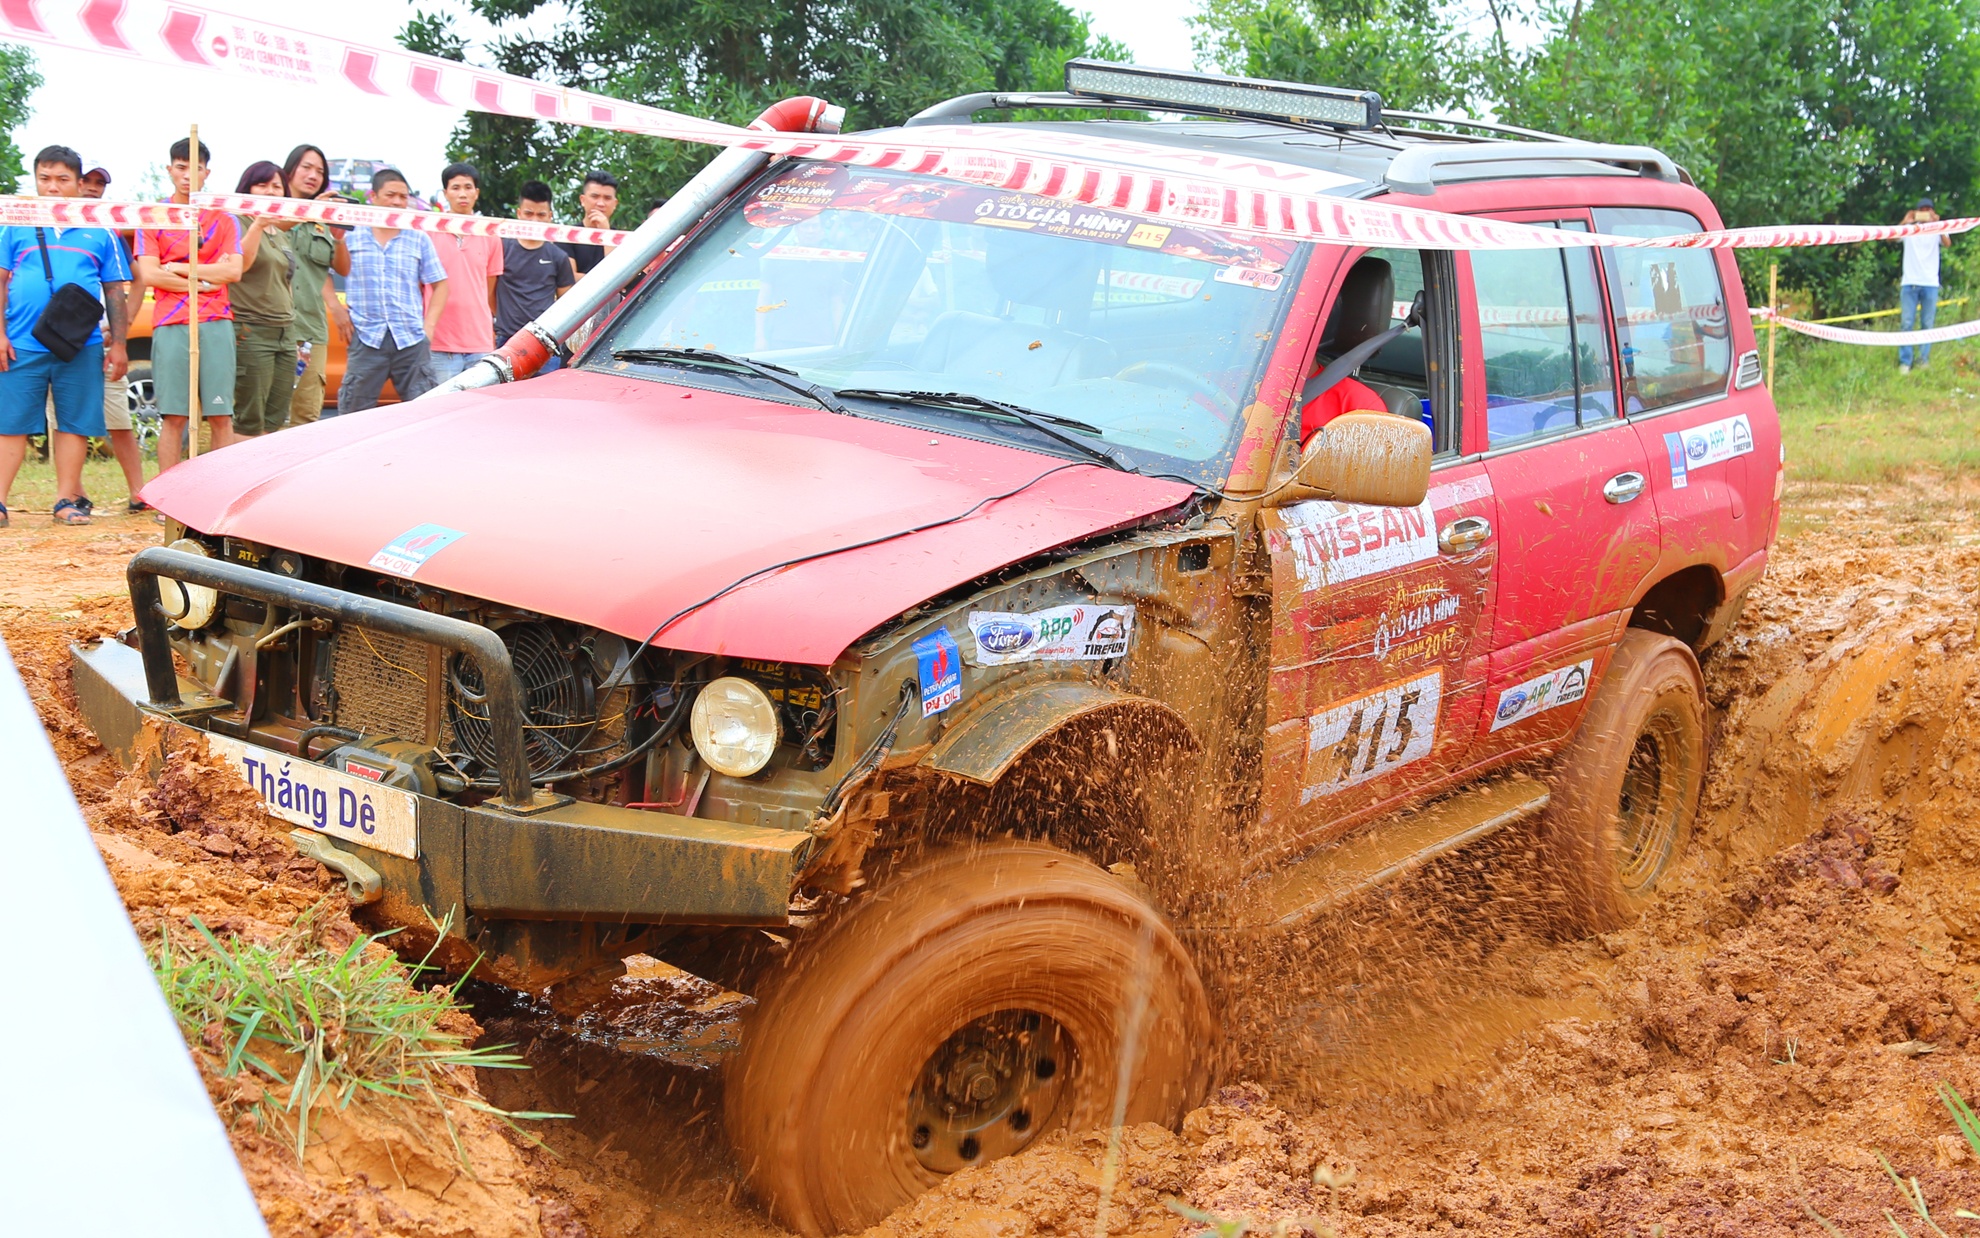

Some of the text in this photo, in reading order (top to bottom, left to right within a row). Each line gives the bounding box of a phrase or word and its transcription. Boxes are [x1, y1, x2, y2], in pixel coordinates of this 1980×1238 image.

[974, 199, 995, 217] Ô
[1074, 211, 1132, 233] HÌNH
[1071, 228, 1098, 238] NAM
[1097, 231, 1123, 240] 2017
[1133, 231, 1166, 242] 415
[1690, 438, 1706, 457] Ford
[1709, 429, 1726, 450] APP
[1300, 505, 1427, 568] NISSAN
[374, 554, 413, 573] PV OIL
[1433, 593, 1461, 623] HÌNH
[987, 622, 1026, 648] Ford
[1038, 616, 1072, 642] APP
[1084, 642, 1126, 656] TIREFUN
[1424, 626, 1456, 660] 2017
[741, 659, 784, 677] ATLAS
[925, 688, 958, 714] PV OIL
[1529, 681, 1552, 703] APP
[242, 757, 376, 836] Thắng Dê
